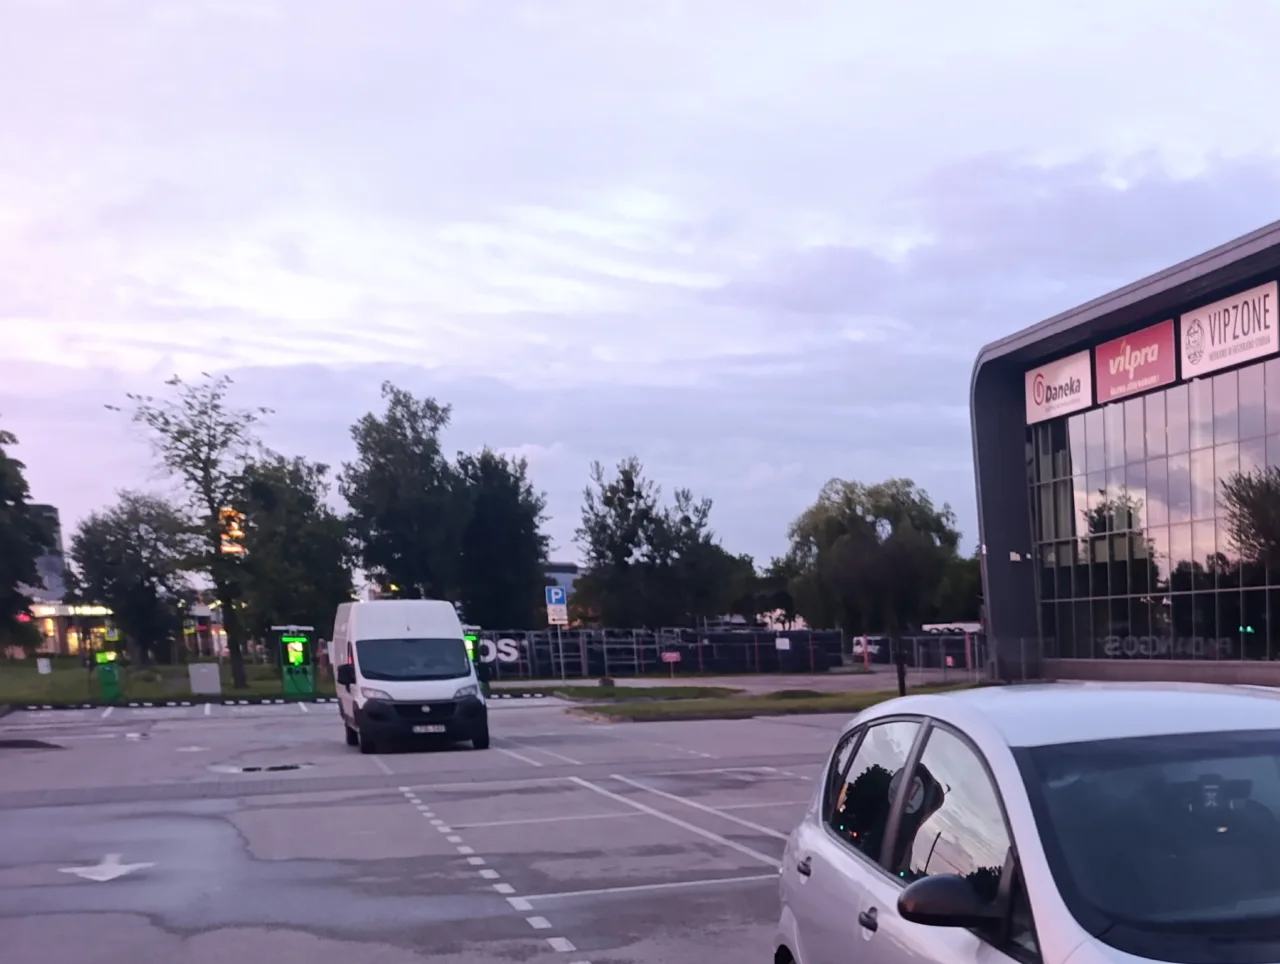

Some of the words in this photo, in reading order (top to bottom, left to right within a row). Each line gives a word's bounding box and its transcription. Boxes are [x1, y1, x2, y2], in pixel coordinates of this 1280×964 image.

[1208, 293, 1270, 347] VIPZONE
[1109, 341, 1159, 380] vilpra
[1045, 376, 1081, 403] Daneka
[552, 589, 562, 603] P
